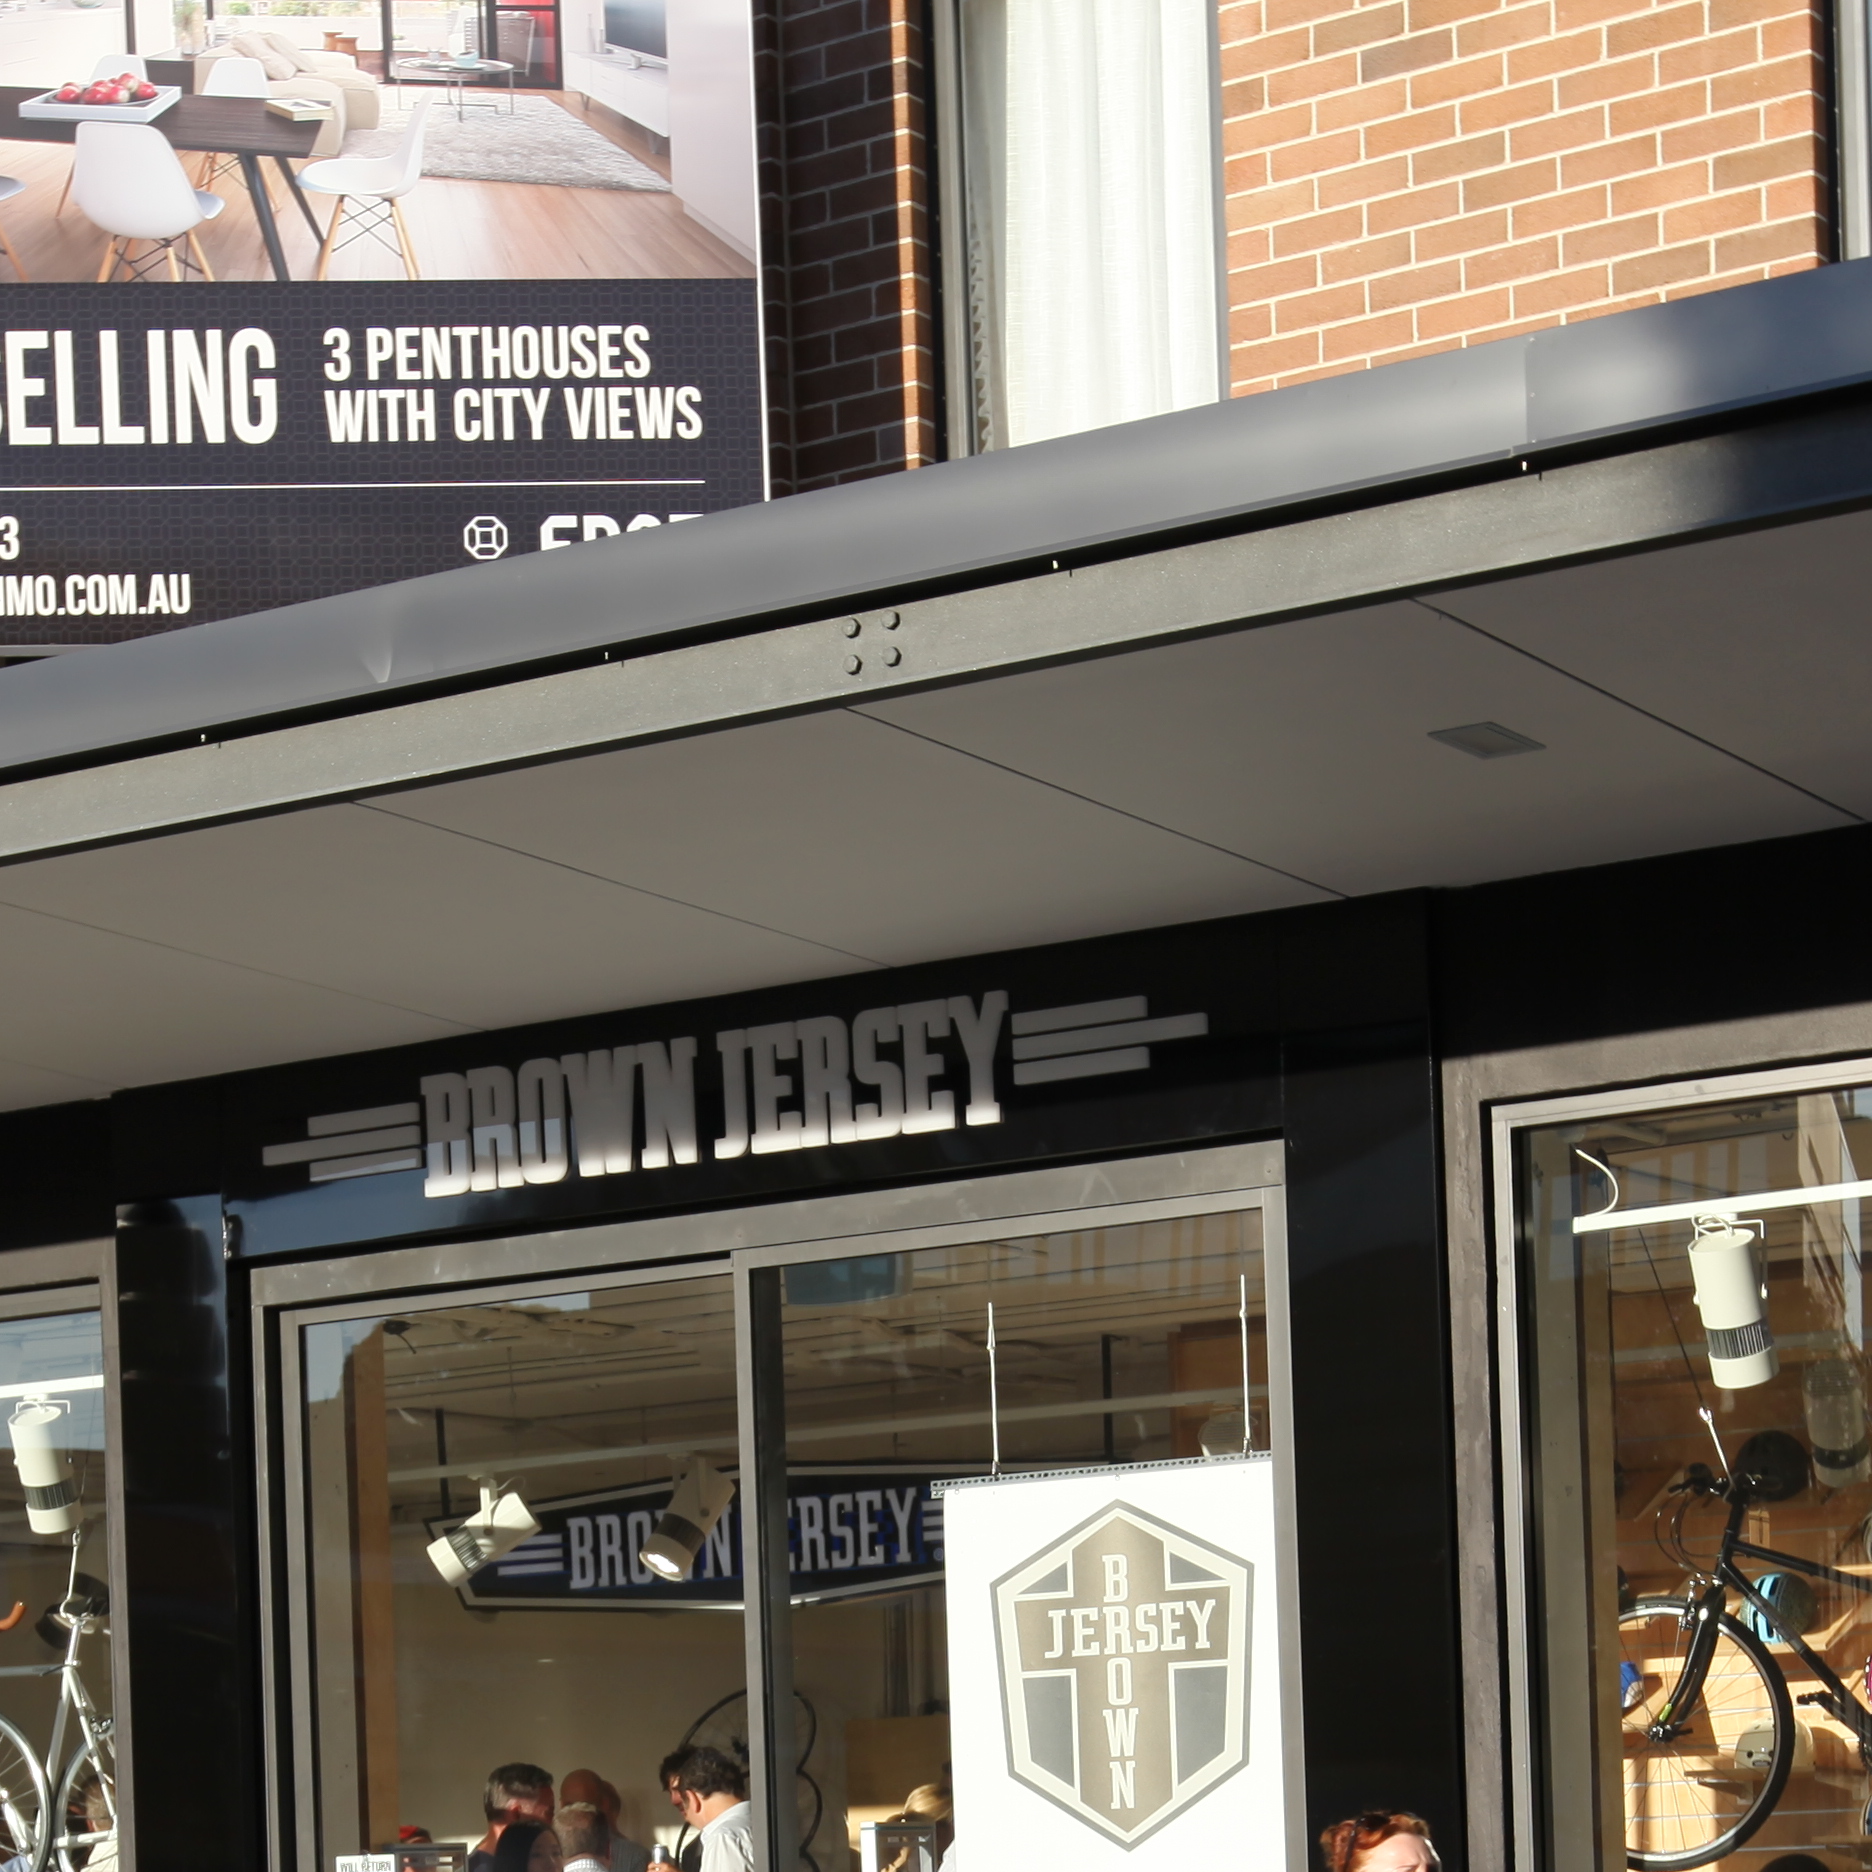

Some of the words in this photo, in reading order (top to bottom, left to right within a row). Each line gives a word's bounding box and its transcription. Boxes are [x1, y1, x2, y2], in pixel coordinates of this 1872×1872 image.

[323, 329, 352, 382] 3
[366, 325, 650, 381] PENTHOUSES
[323, 388, 436, 443] WITH
[453, 387, 552, 441] CITY
[567, 384, 702, 440] VIEWS
[539, 513, 705, 551] ED
[421, 1035, 699, 1198] BROWN
[714, 990, 1009, 1159] JERSEY
[566, 1504, 732, 1589] BRON
[1044, 1598, 1216, 1659] JERSEY
[1102, 1553, 1139, 1809] BROWN
[340, 1862, 358, 1872] WILL
[360, 1861, 390, 1872] RETURN
